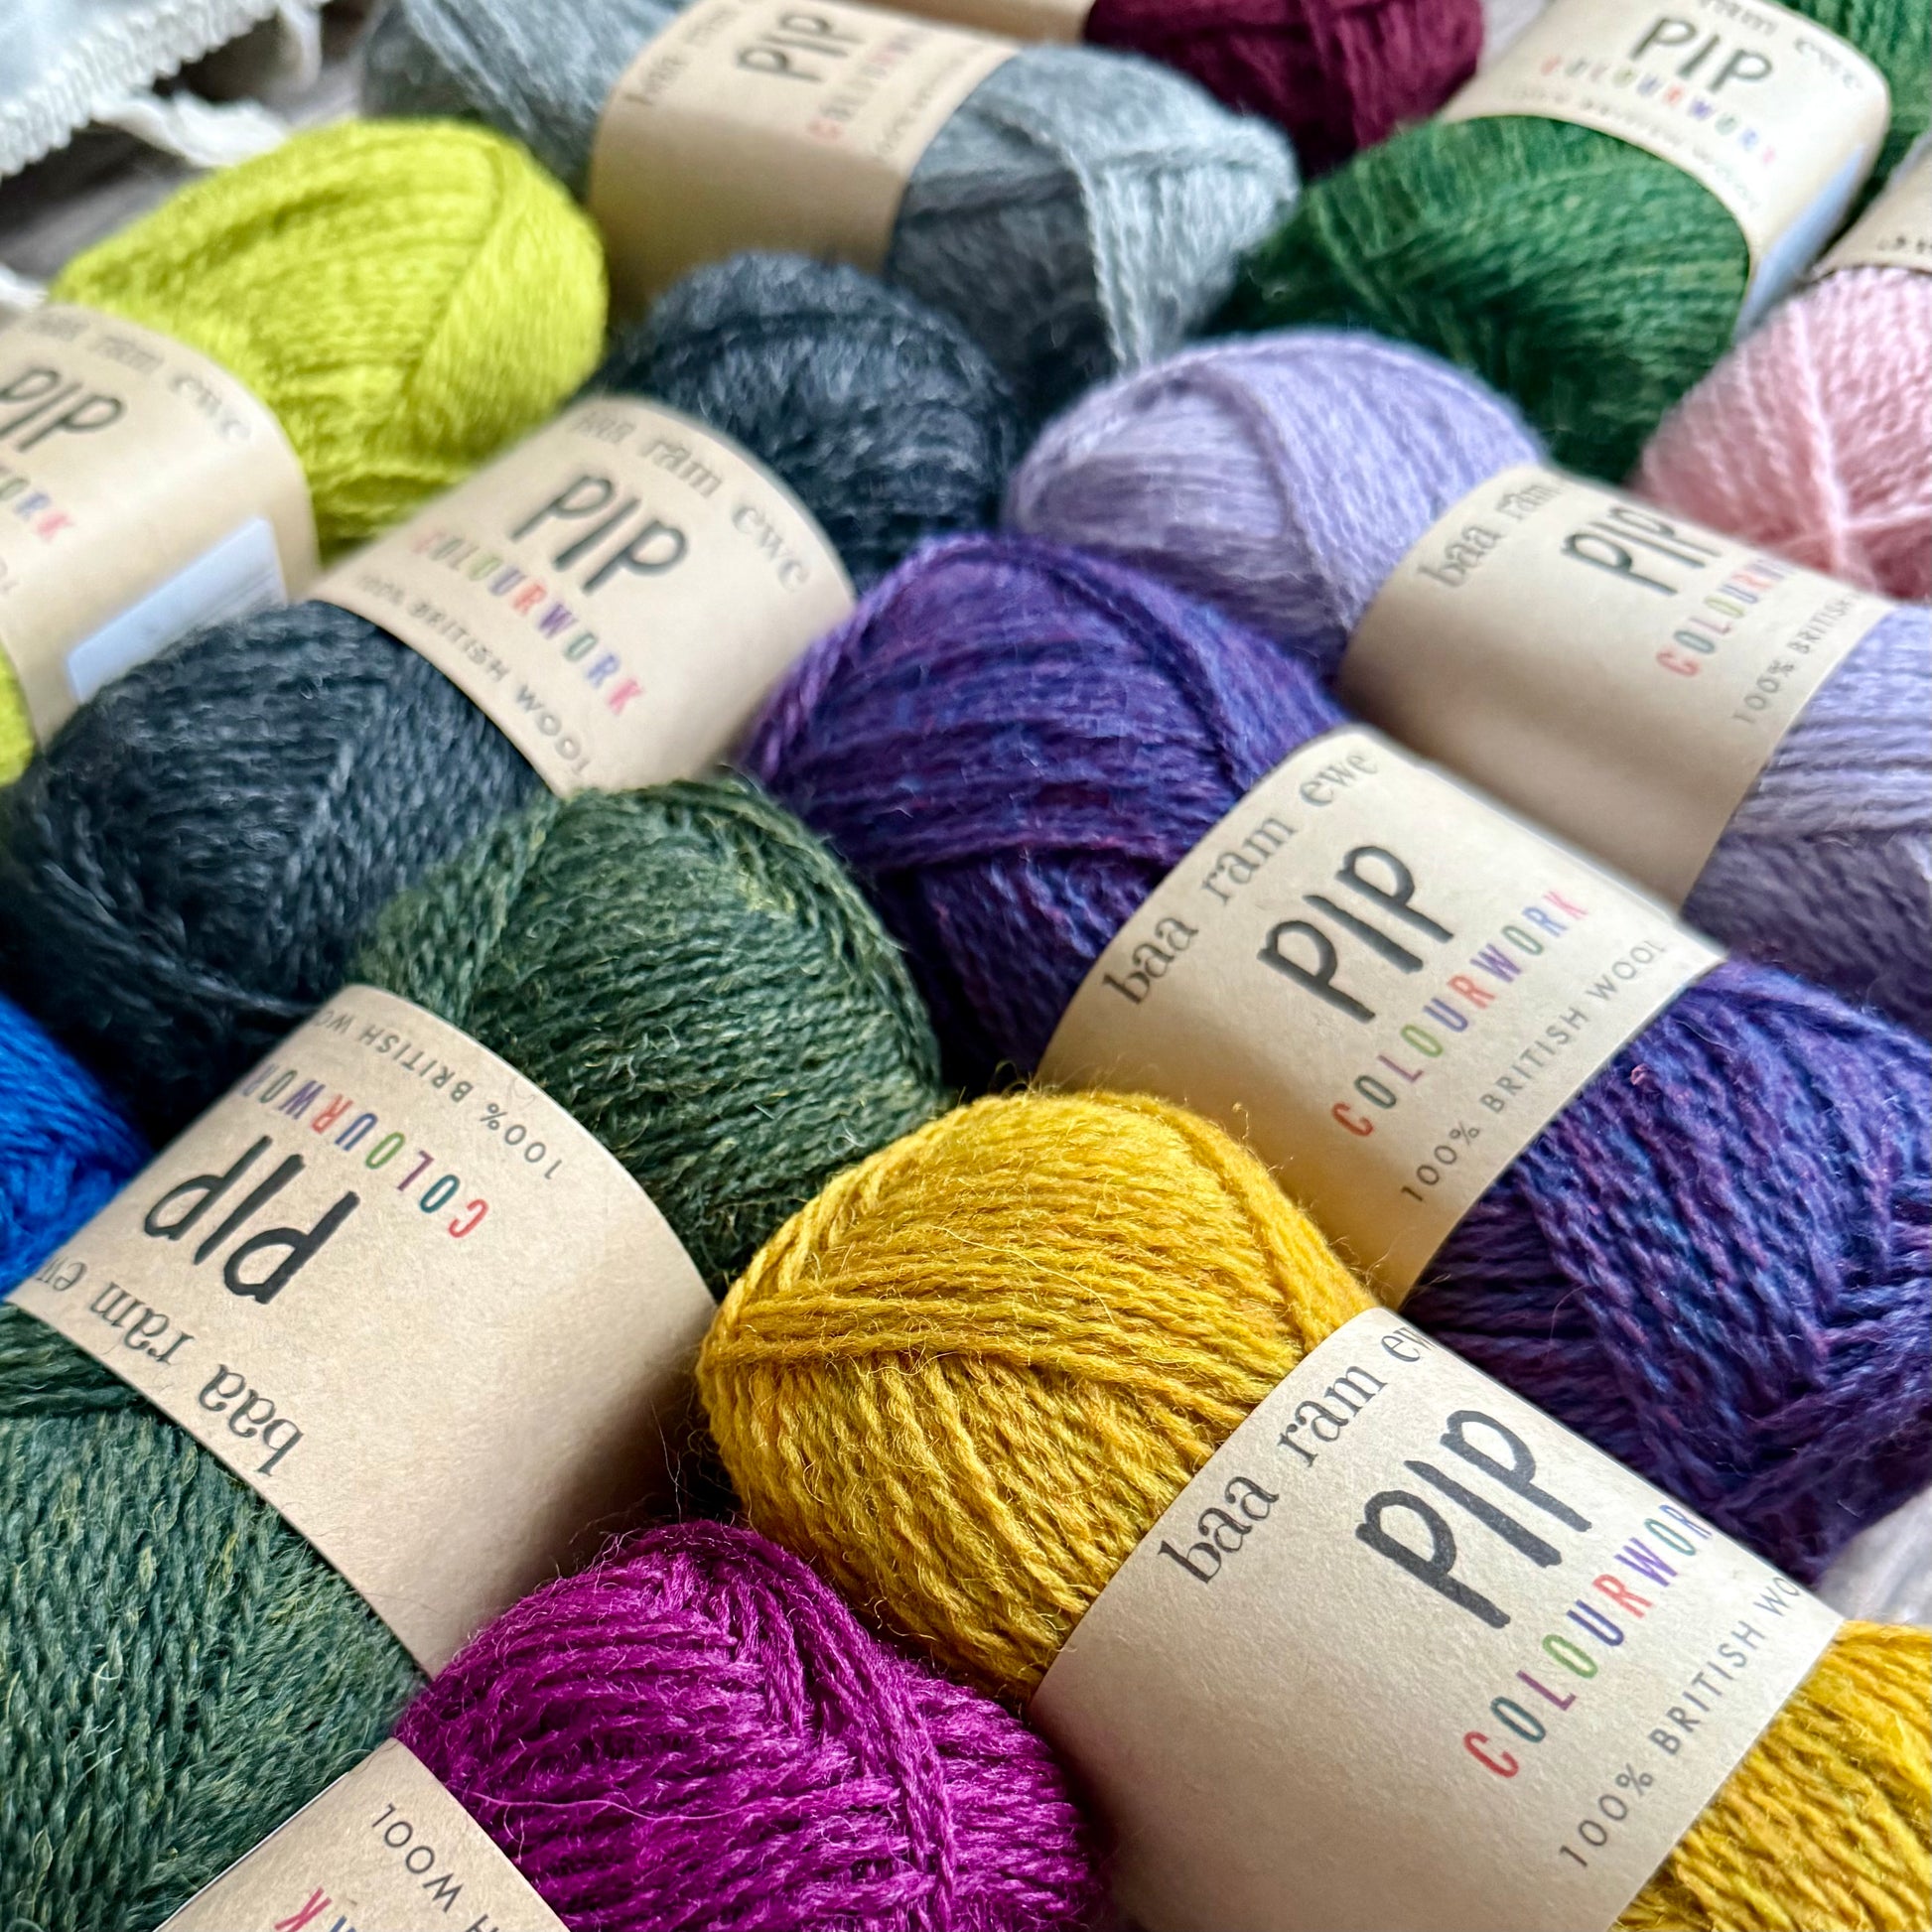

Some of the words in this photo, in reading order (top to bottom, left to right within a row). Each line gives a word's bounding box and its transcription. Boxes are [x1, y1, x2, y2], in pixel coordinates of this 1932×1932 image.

[736, 11, 868, 83] PIP
[1627, 16, 1773, 94] PIP
[507, 475, 689, 595] PIP
[1417, 524, 1505, 588] baa
[1560, 506, 1723, 597] PIP
[412, 530, 645, 716] COLOURWORK
[515, 684, 591, 775] WOOL
[1731, 660, 1796, 724] 100%
[1102, 916, 1199, 1005] baa
[1201, 817, 1298, 906] ram
[1299, 753, 1379, 807] ewe
[1256, 844, 1455, 1025] PIP
[358, 1023, 475, 1103] BRITISH
[1330, 891, 1588, 1138] COLOURWORK
[1401, 1121, 1480, 1202] 100%
[1478, 1006, 1591, 1114] BRITISH
[1586, 939, 1668, 1002] WOOL
[241, 1063, 489, 1239] COLOURWOR
[479, 1103, 563, 1180] 100%
[144, 1134, 360, 1306] PIP
[89, 1281, 195, 1365] ram
[198, 1363, 305, 1477] baa
[1157, 1475, 1280, 1585] baa
[1277, 1365, 1388, 1468] ram
[1355, 1409, 1592, 1629] PIP
[1463, 1504, 1713, 1779] COLOURWOR
[1559, 1762, 1654, 1867] 100%
[1648, 1619, 1766, 1755] BRITISH
[1753, 1577, 1800, 1617] WO
[371, 1803, 464, 1913] WOOL
